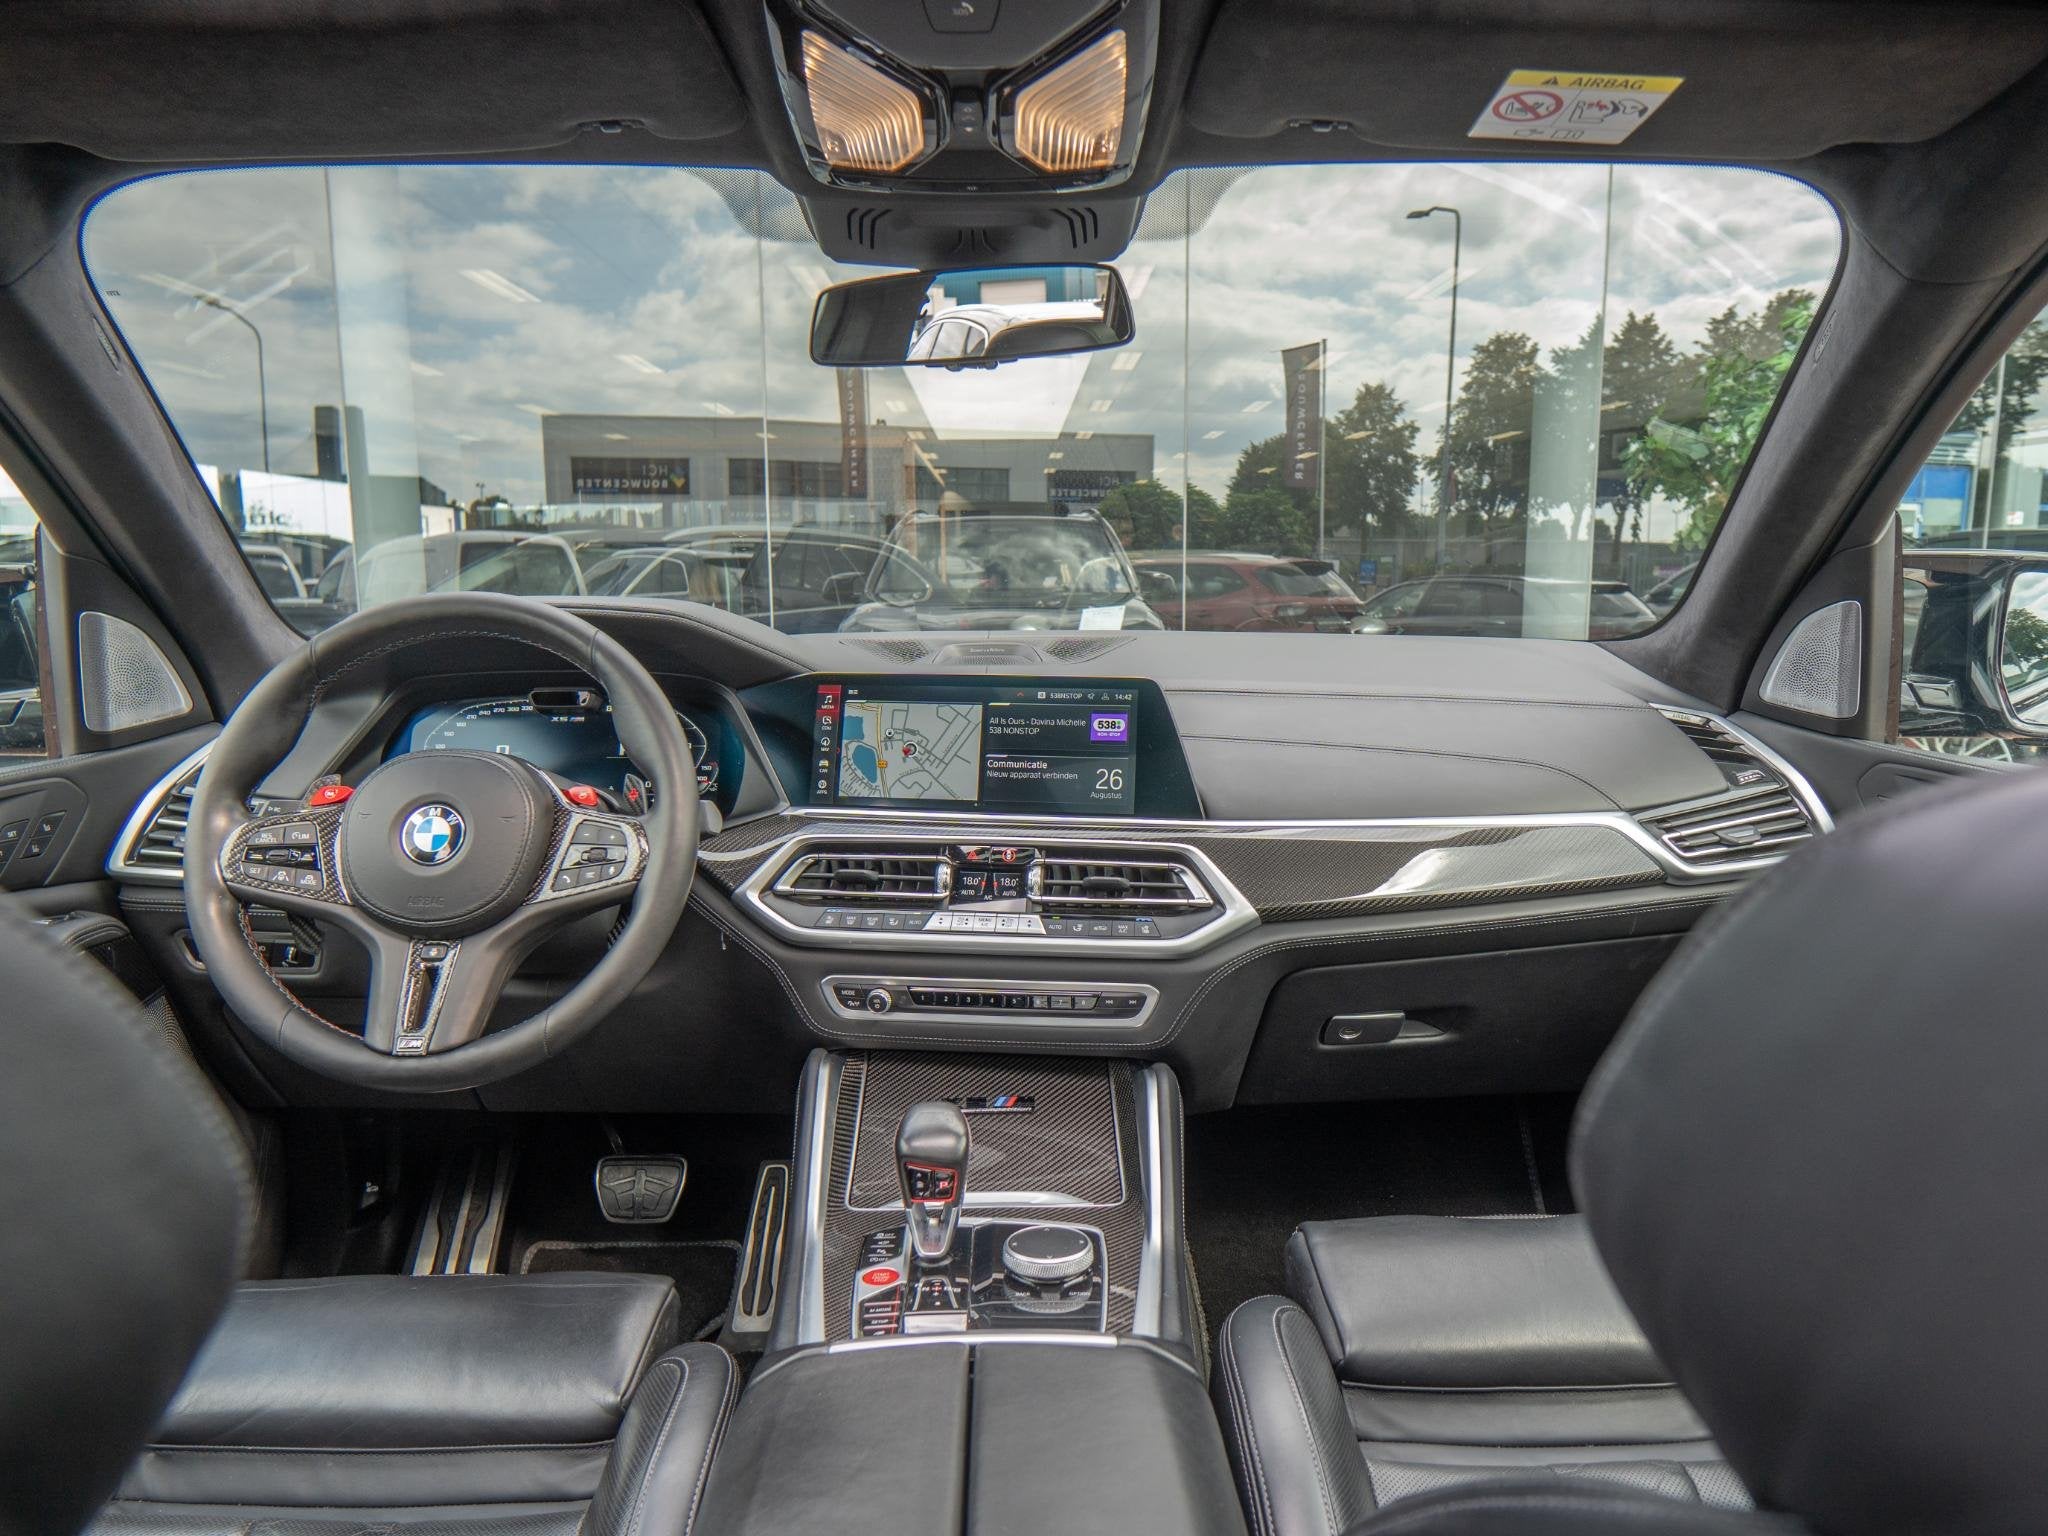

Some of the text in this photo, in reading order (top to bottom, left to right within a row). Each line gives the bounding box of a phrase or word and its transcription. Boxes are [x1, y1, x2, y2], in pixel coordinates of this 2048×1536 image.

[1569, 77, 1645, 90] AIRBAG
[989, 717, 999, 725] All
[1007, 718, 1025, 726] Ours
[1031, 718, 1055, 726] Davina
[1056, 719, 1087, 728] Michelle
[1097, 720, 1117, 730] 538
[989, 727, 1040, 735] 538 NONSTOP
[987, 760, 1048, 769] Communicatie
[1009, 771, 1041, 779] apparaat
[1042, 771, 1078, 780] verbinden
[1095, 768, 1123, 790] 26
[1090, 791, 1122, 799] Augustus
[939, 1181, 949, 1189] P
